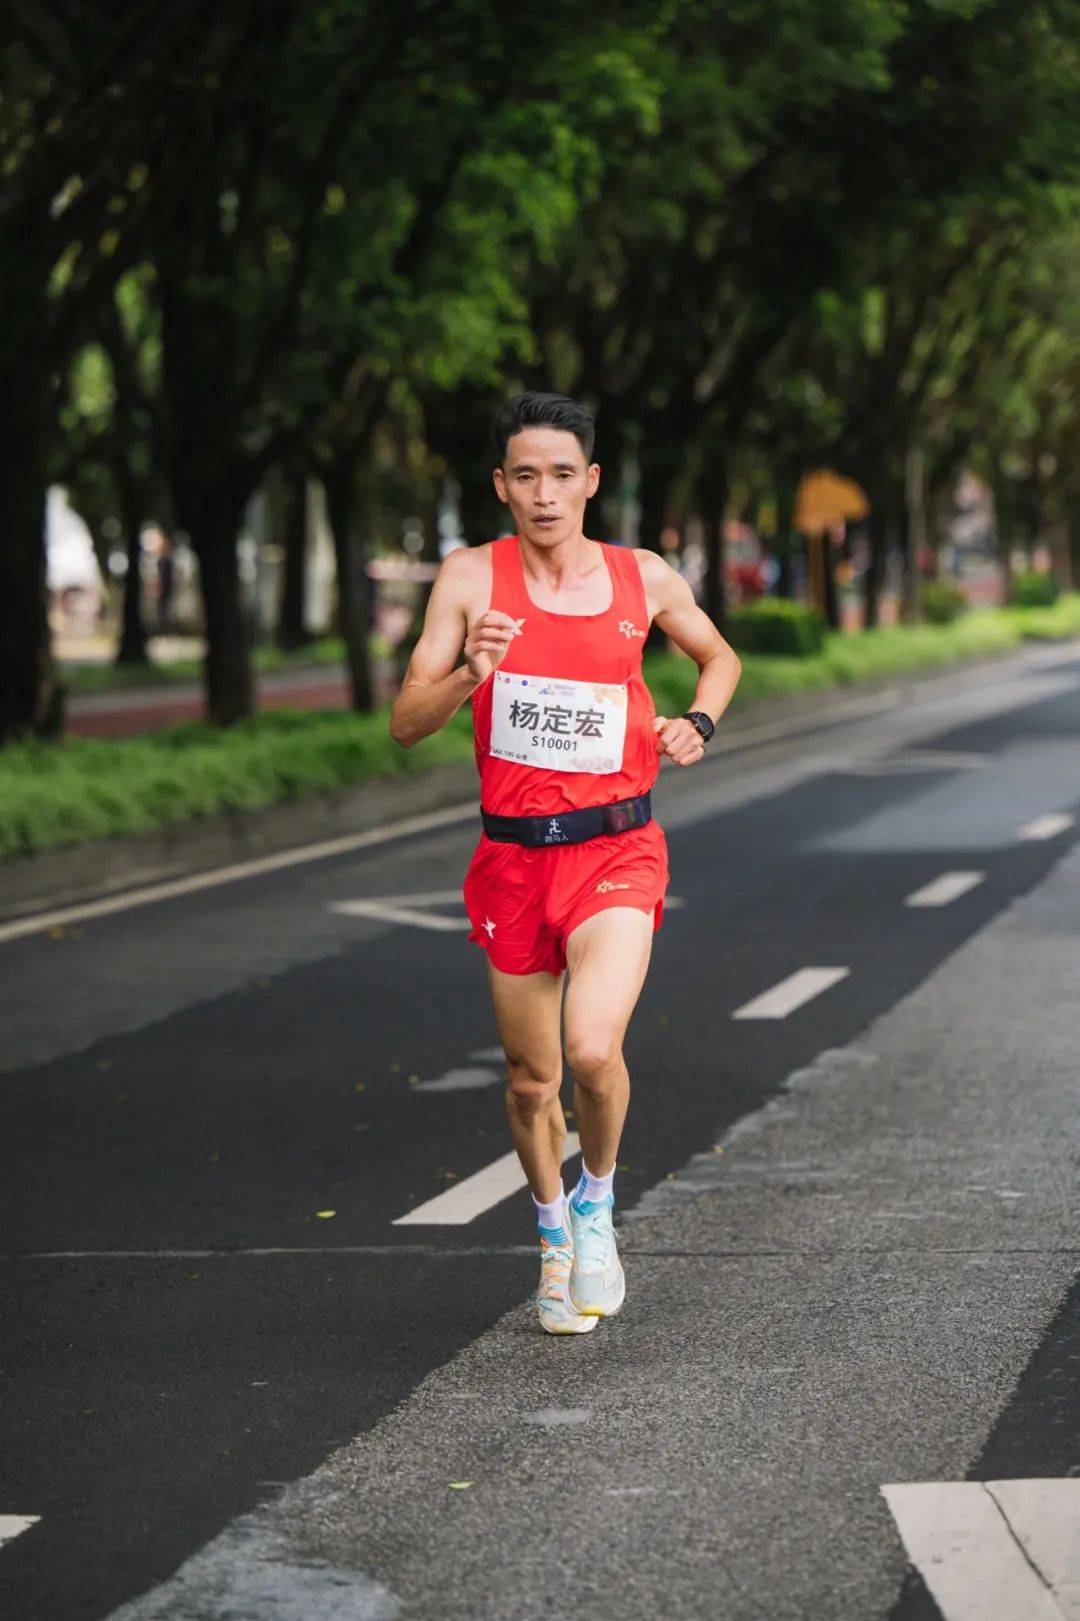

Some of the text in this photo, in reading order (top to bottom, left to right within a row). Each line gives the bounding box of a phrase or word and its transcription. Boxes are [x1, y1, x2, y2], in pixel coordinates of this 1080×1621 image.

[509, 700, 605, 738] 杨定宏
[531, 735, 578, 752] S10001
